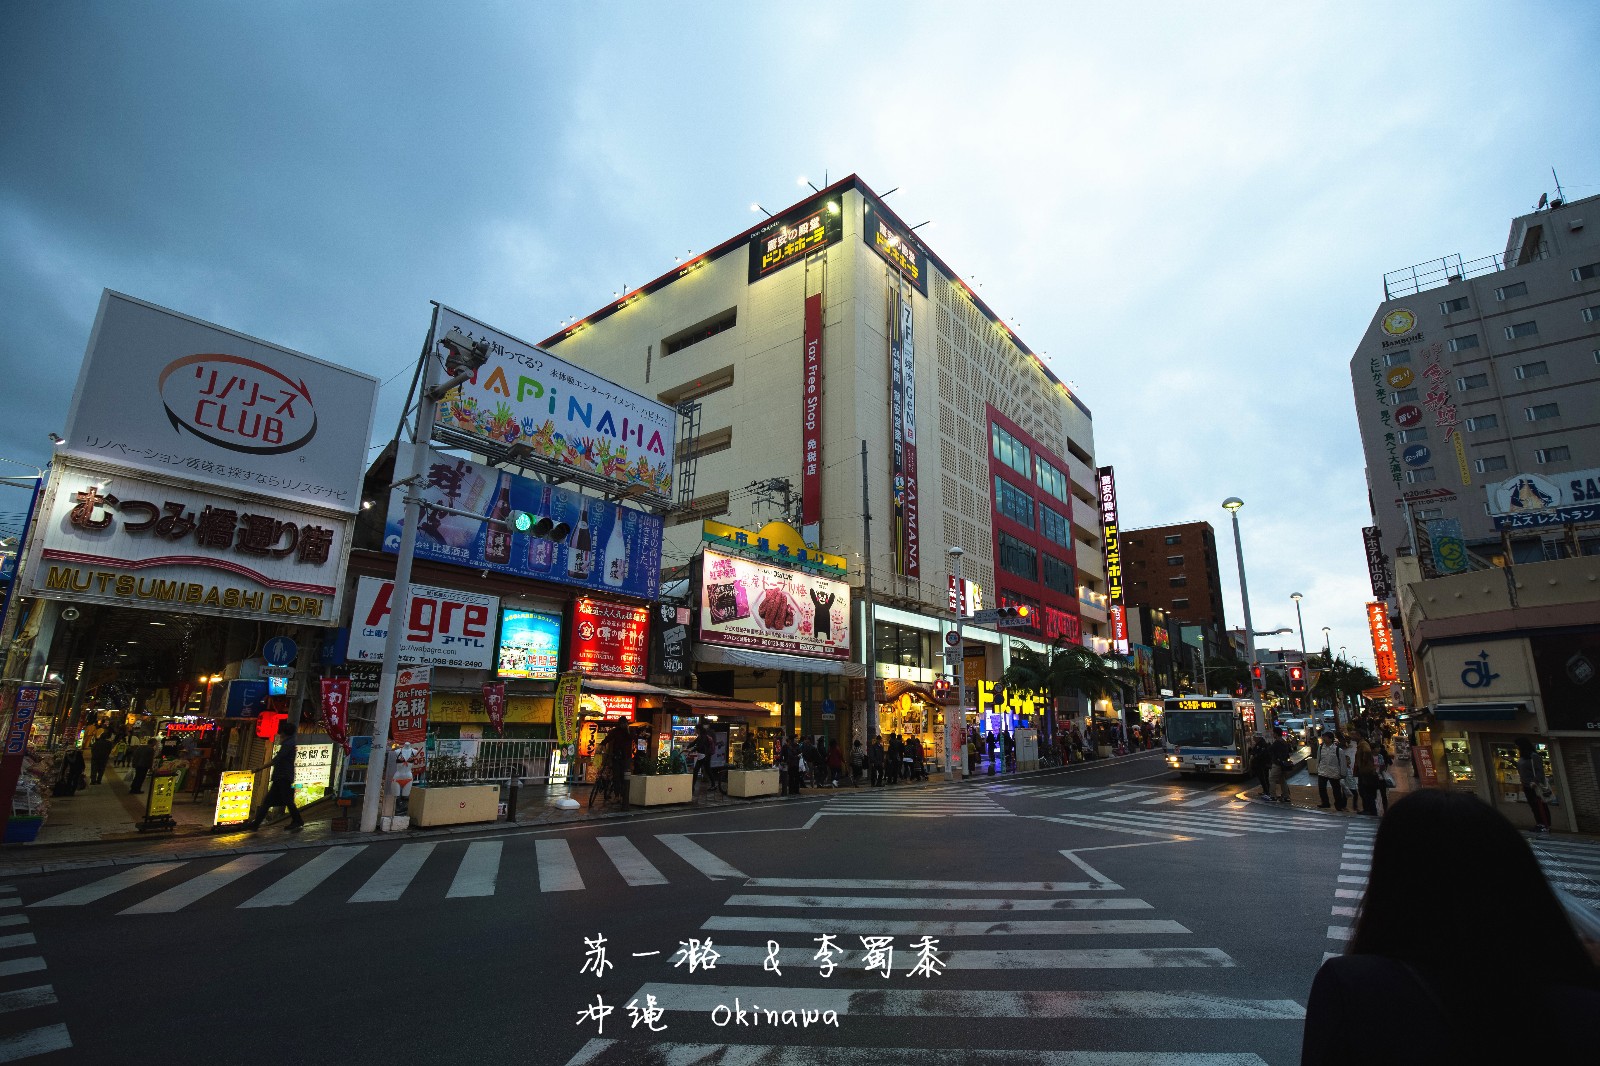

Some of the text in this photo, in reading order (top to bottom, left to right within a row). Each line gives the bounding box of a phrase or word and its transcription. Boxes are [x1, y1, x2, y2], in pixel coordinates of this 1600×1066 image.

[195, 365, 299, 419] リノリース
[807, 339, 818, 430] Tax Free Shop
[194, 399, 284, 444] CLUB
[807, 438, 817, 476] 免税店
[1571, 477, 1600, 501] SA
[69, 486, 335, 566] むつみ橋通り街
[907, 475, 917, 570] KAIMANA
[1538, 509, 1595, 523] レストラン
[1367, 538, 1386, 590] ホテル山の内
[46, 566, 323, 617] MUTSUMIBASHI DORI
[441, 635, 485, 648] アグレ
[394, 698, 426, 719] 免税
[396, 688, 427, 698] Tax-Free
[167, 723, 213, 731] WELCOME
[397, 717, 422, 730] 면세
